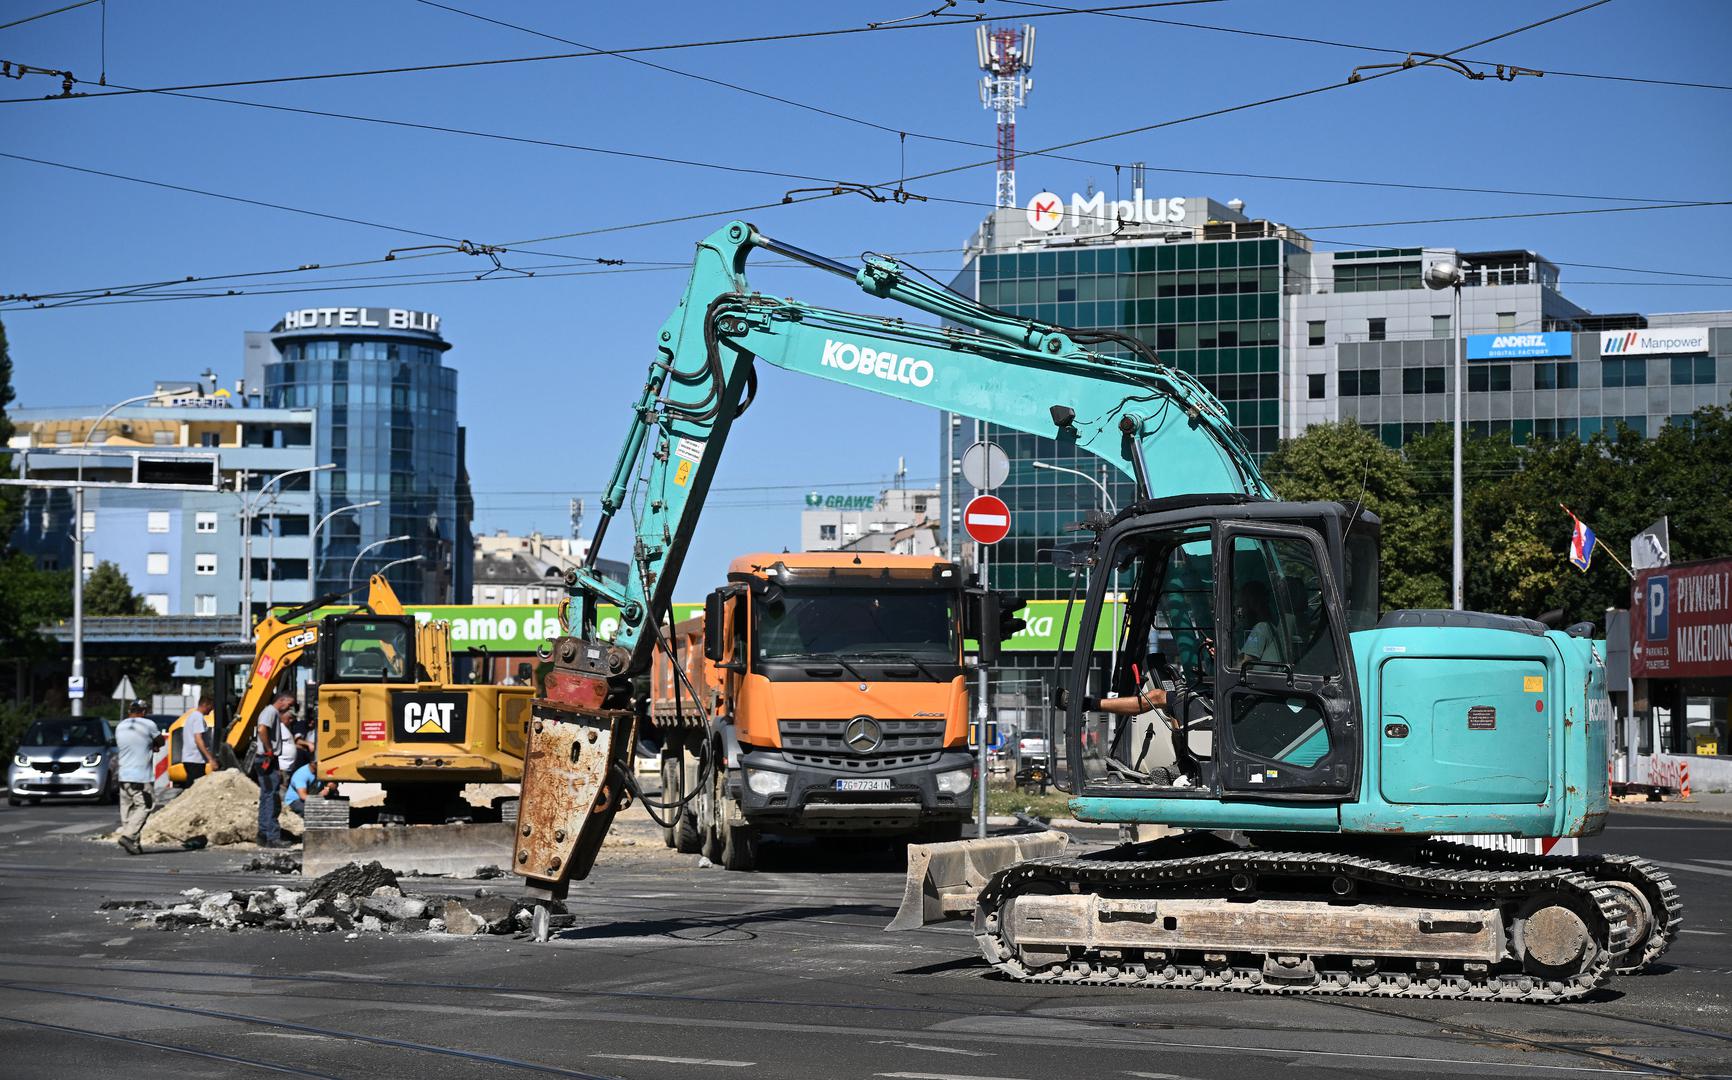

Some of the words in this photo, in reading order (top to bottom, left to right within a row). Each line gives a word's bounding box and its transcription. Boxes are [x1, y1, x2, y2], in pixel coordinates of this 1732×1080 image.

[285, 308, 379, 329] HOTEL
[1491, 335, 1546, 348] ANDRITZ
[1641, 337, 1703, 350] Manpower
[821, 339, 934, 387] KOBELCO
[825, 495, 875, 508] GRAWE
[287, 631, 314, 648] JCB
[404, 702, 455, 733] CAT
